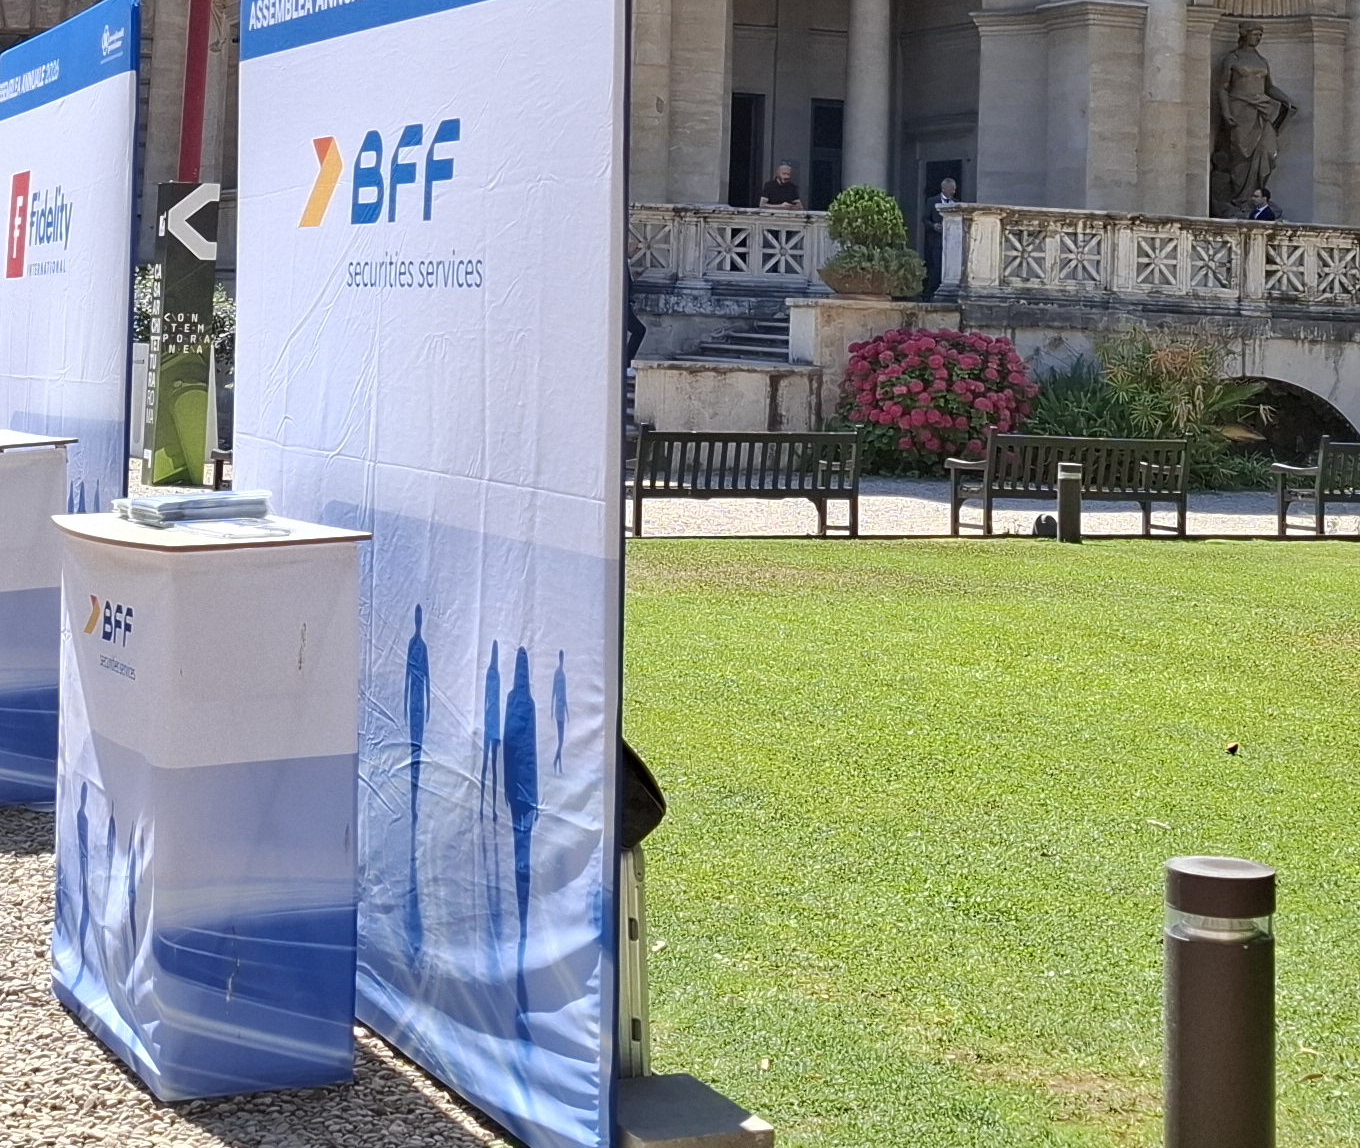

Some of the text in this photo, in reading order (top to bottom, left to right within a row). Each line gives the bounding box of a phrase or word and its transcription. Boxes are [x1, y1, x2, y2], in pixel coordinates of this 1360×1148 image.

[350, 117, 461, 225] BFF
[28, 184, 73, 251] Fidelity
[346, 249, 483, 289] securities services
[101, 600, 134, 648] BFF
